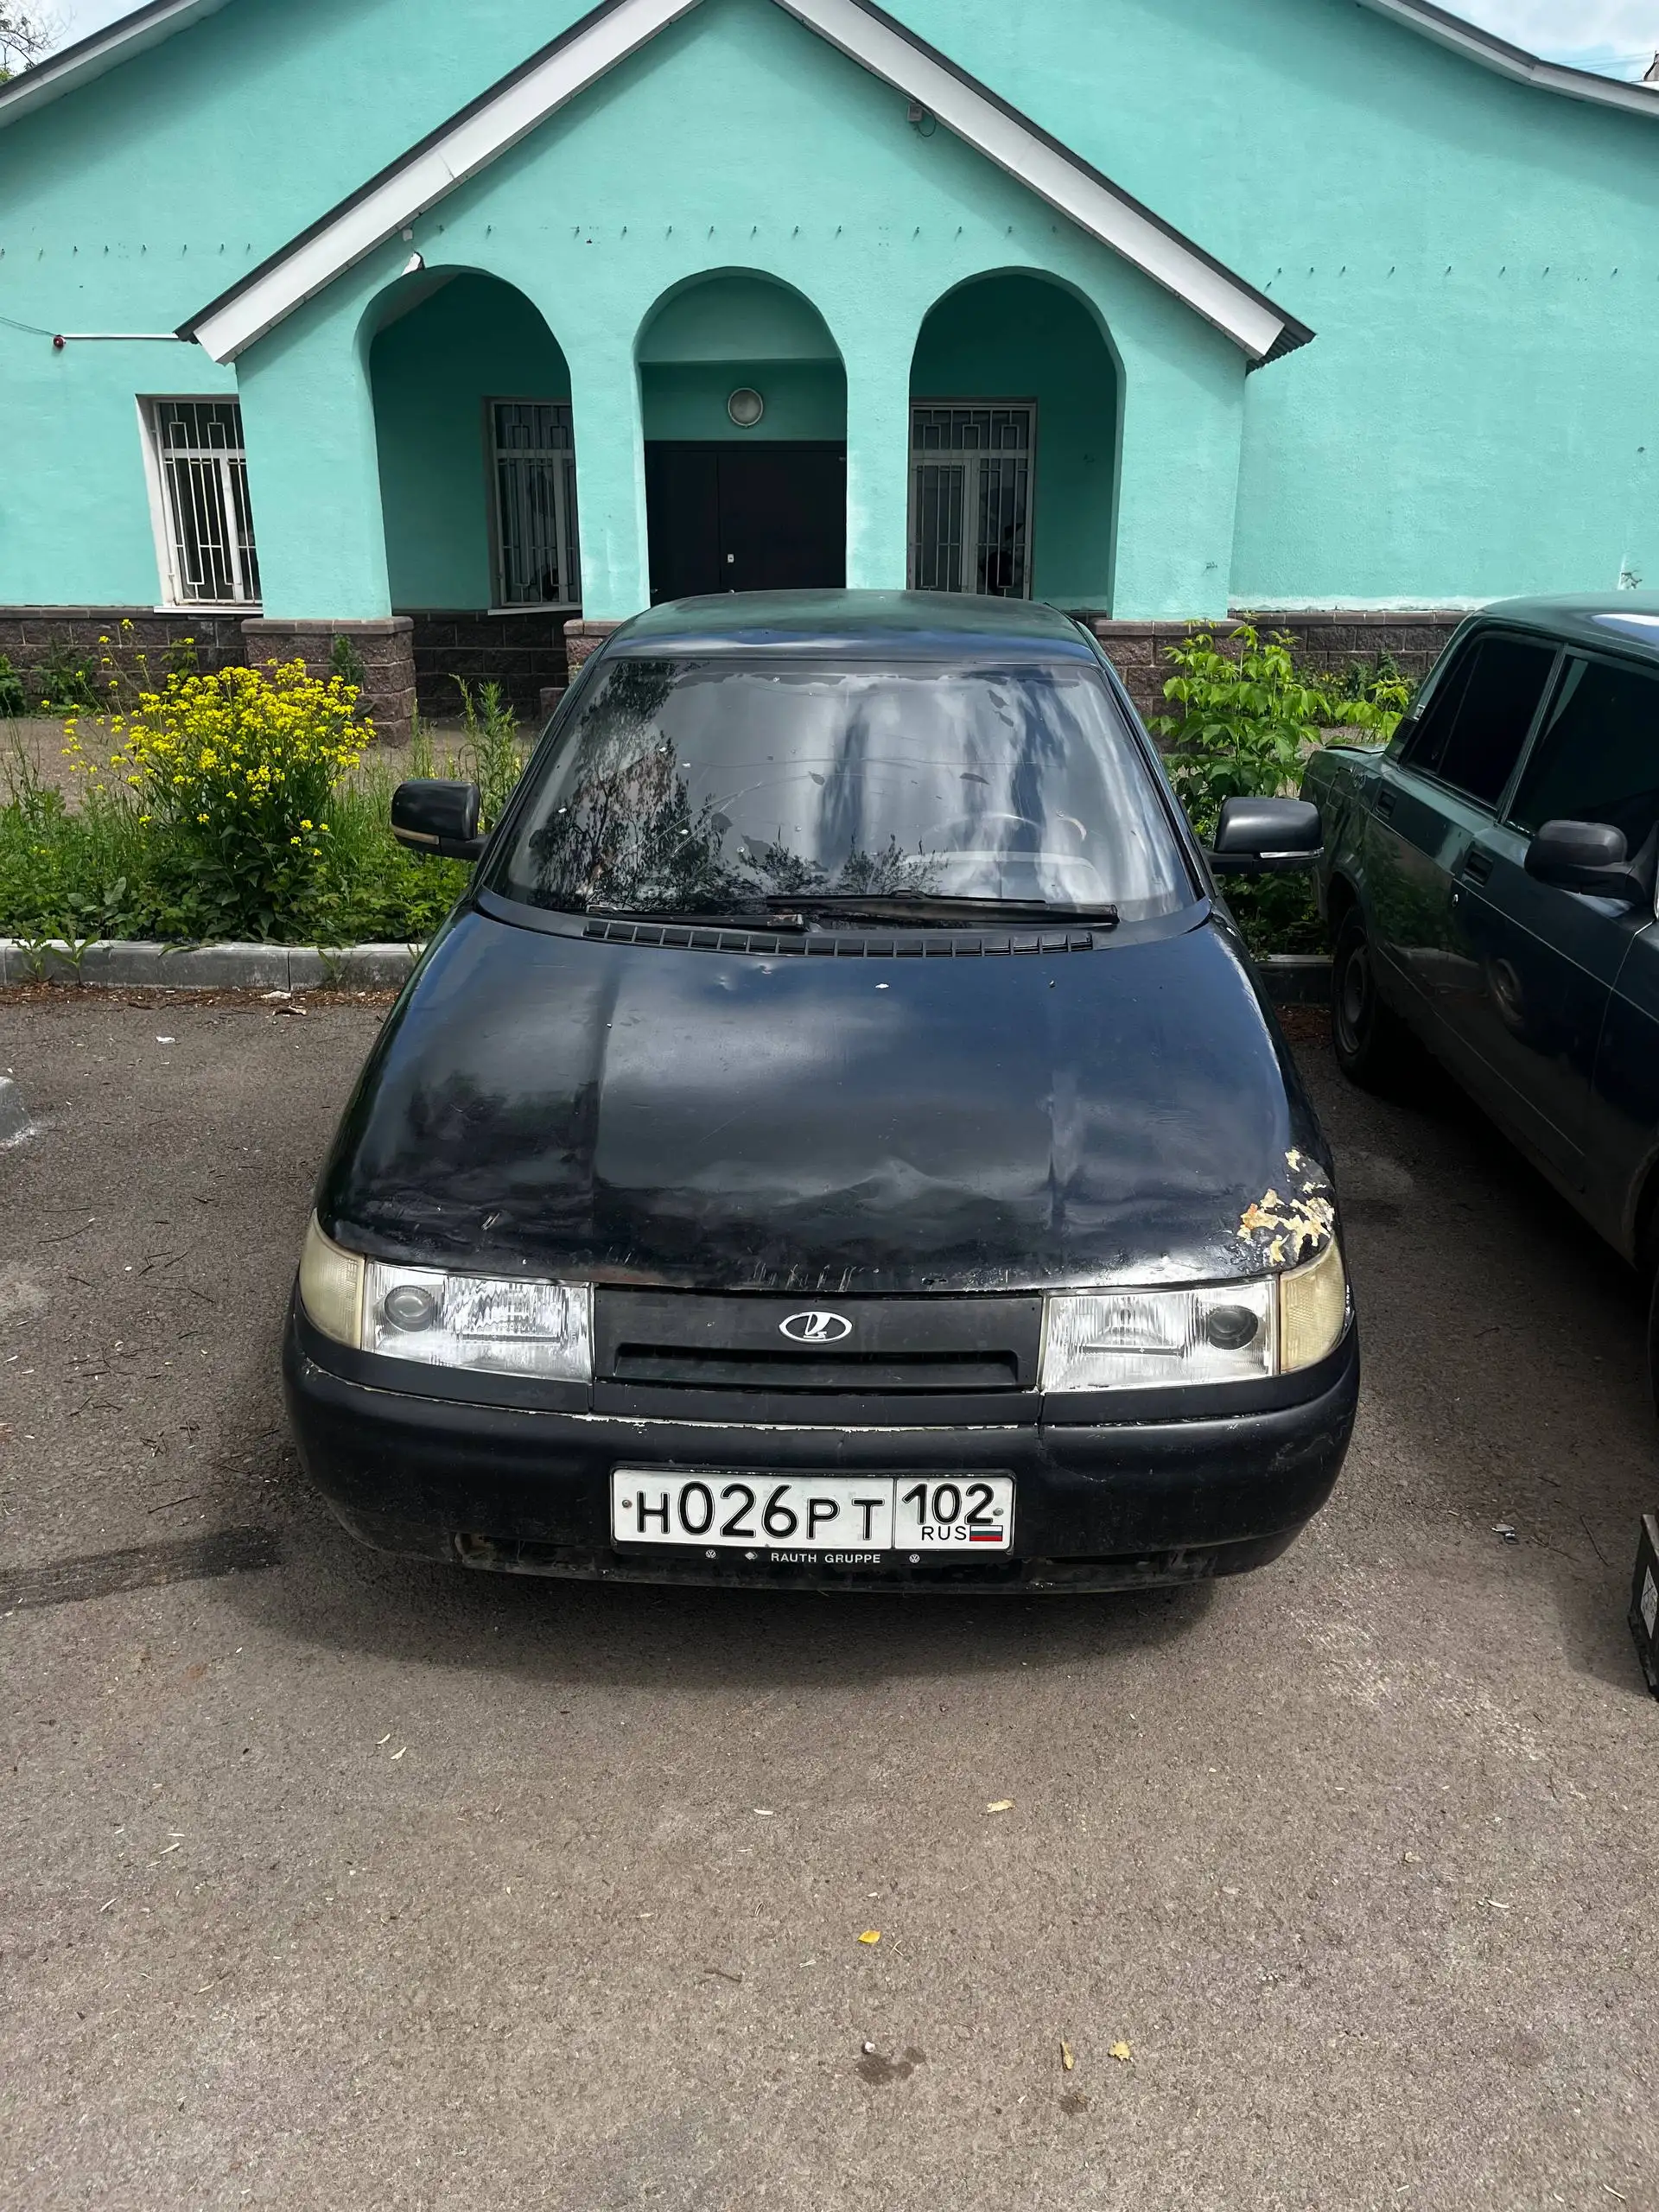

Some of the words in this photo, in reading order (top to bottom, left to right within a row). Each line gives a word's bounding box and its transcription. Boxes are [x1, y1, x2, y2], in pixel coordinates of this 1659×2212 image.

[902, 1483, 995, 1525] 102
[921, 1526, 967, 1541] RUS
[771, 1553, 817, 1563] RAUTH
[824, 1554, 881, 1564] GRUPPE
